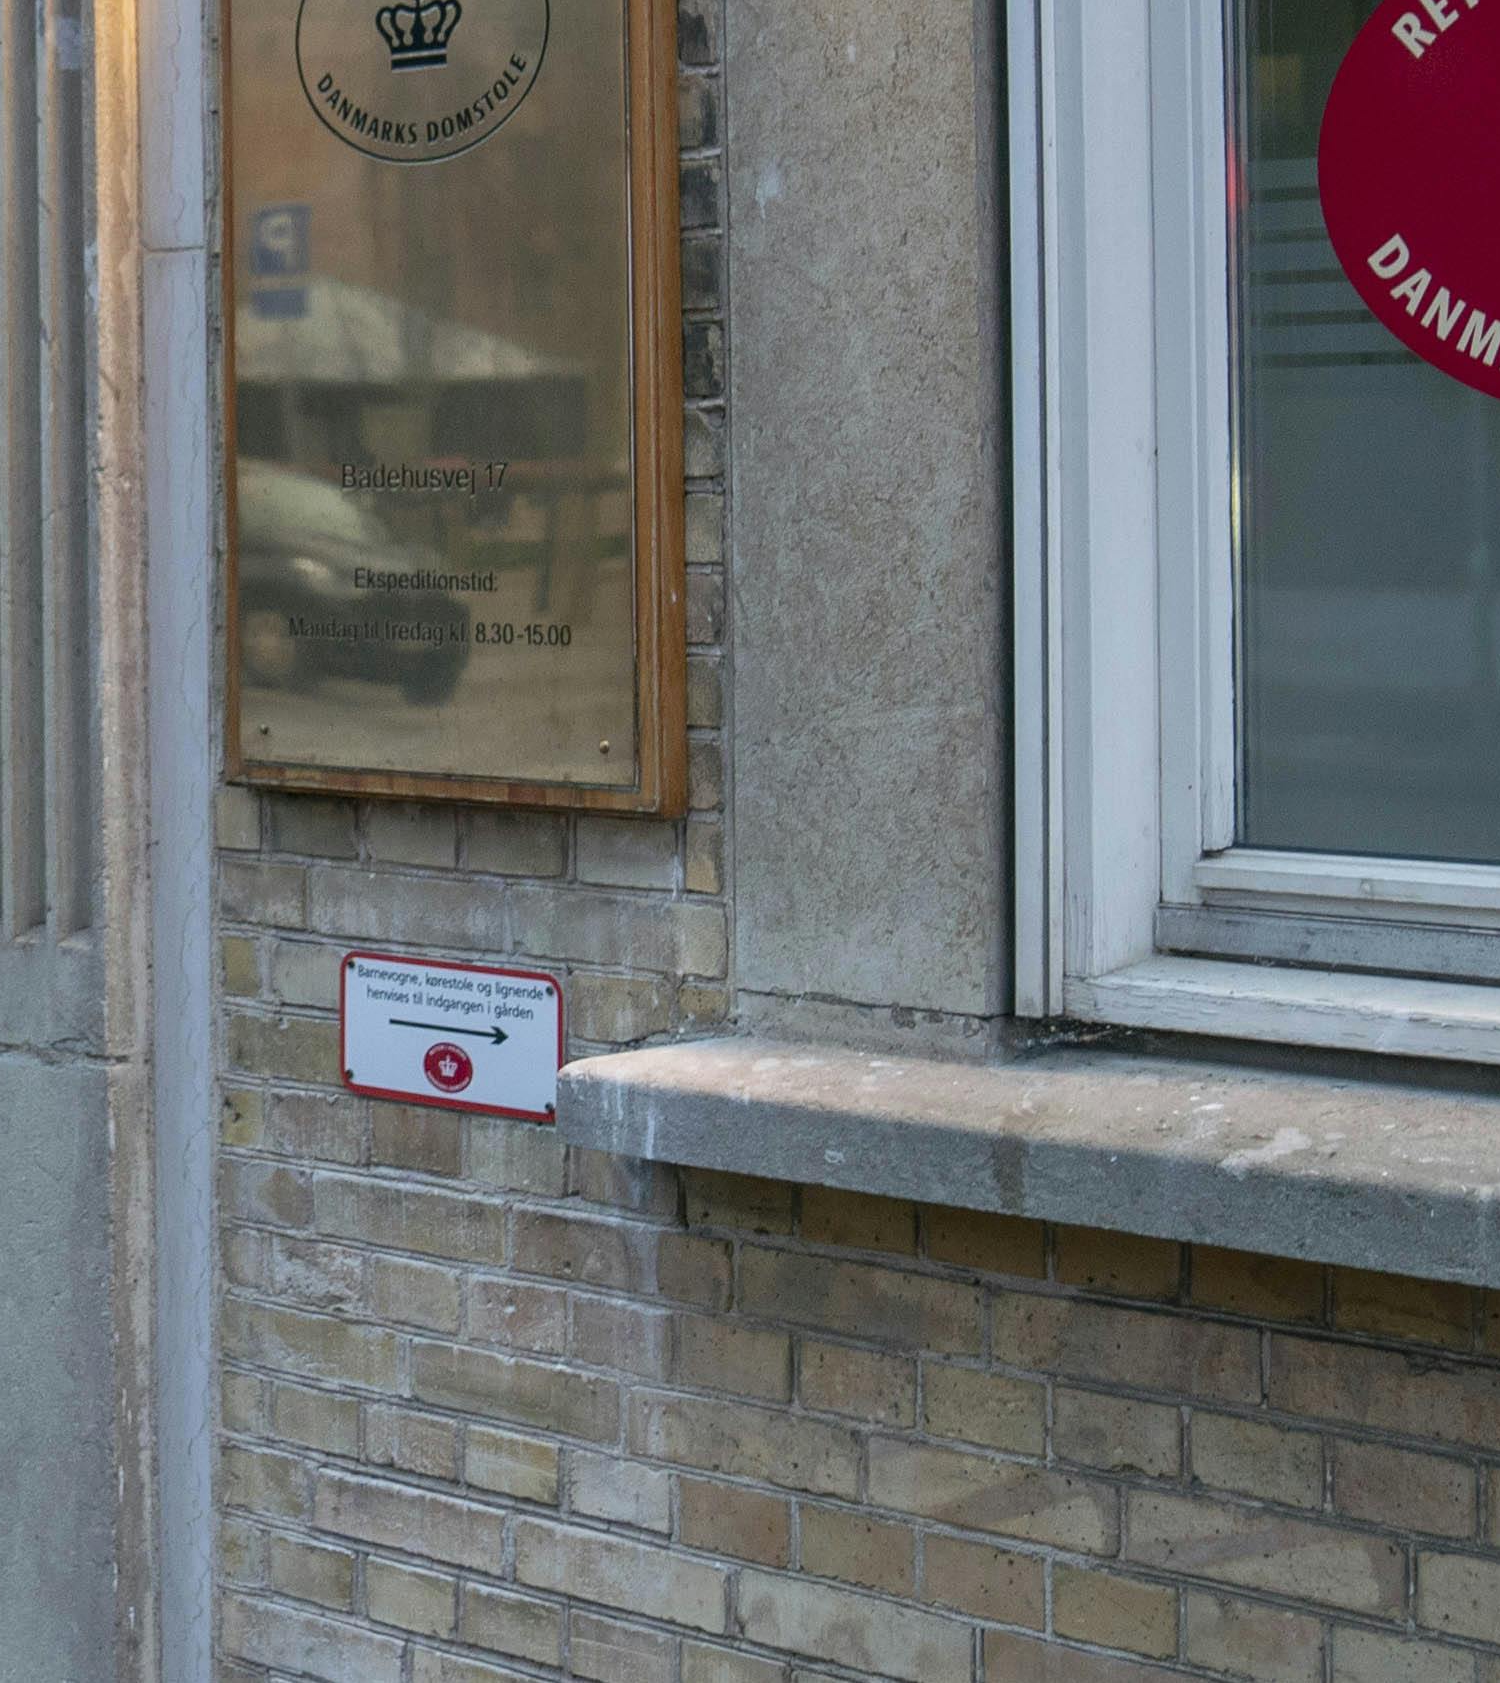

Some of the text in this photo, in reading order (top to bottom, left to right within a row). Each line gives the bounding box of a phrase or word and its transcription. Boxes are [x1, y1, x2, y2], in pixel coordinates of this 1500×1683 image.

[317, 54, 527, 145] DANMARKS DOMSTOLE
[341, 463, 508, 497] Badehusvej 17
[354, 568, 499, 593] Ekspeditionstid:
[288, 617, 358, 641] Mandag
[384, 619, 444, 647] fredag
[358, 964, 544, 1001] Barnevogne, kørestole og lignende
[367, 984, 410, 1003] henvises
[413, 990, 423, 1005] til
[426, 994, 484, 1015] indgangen
[494, 1001, 534, 1020] gården
